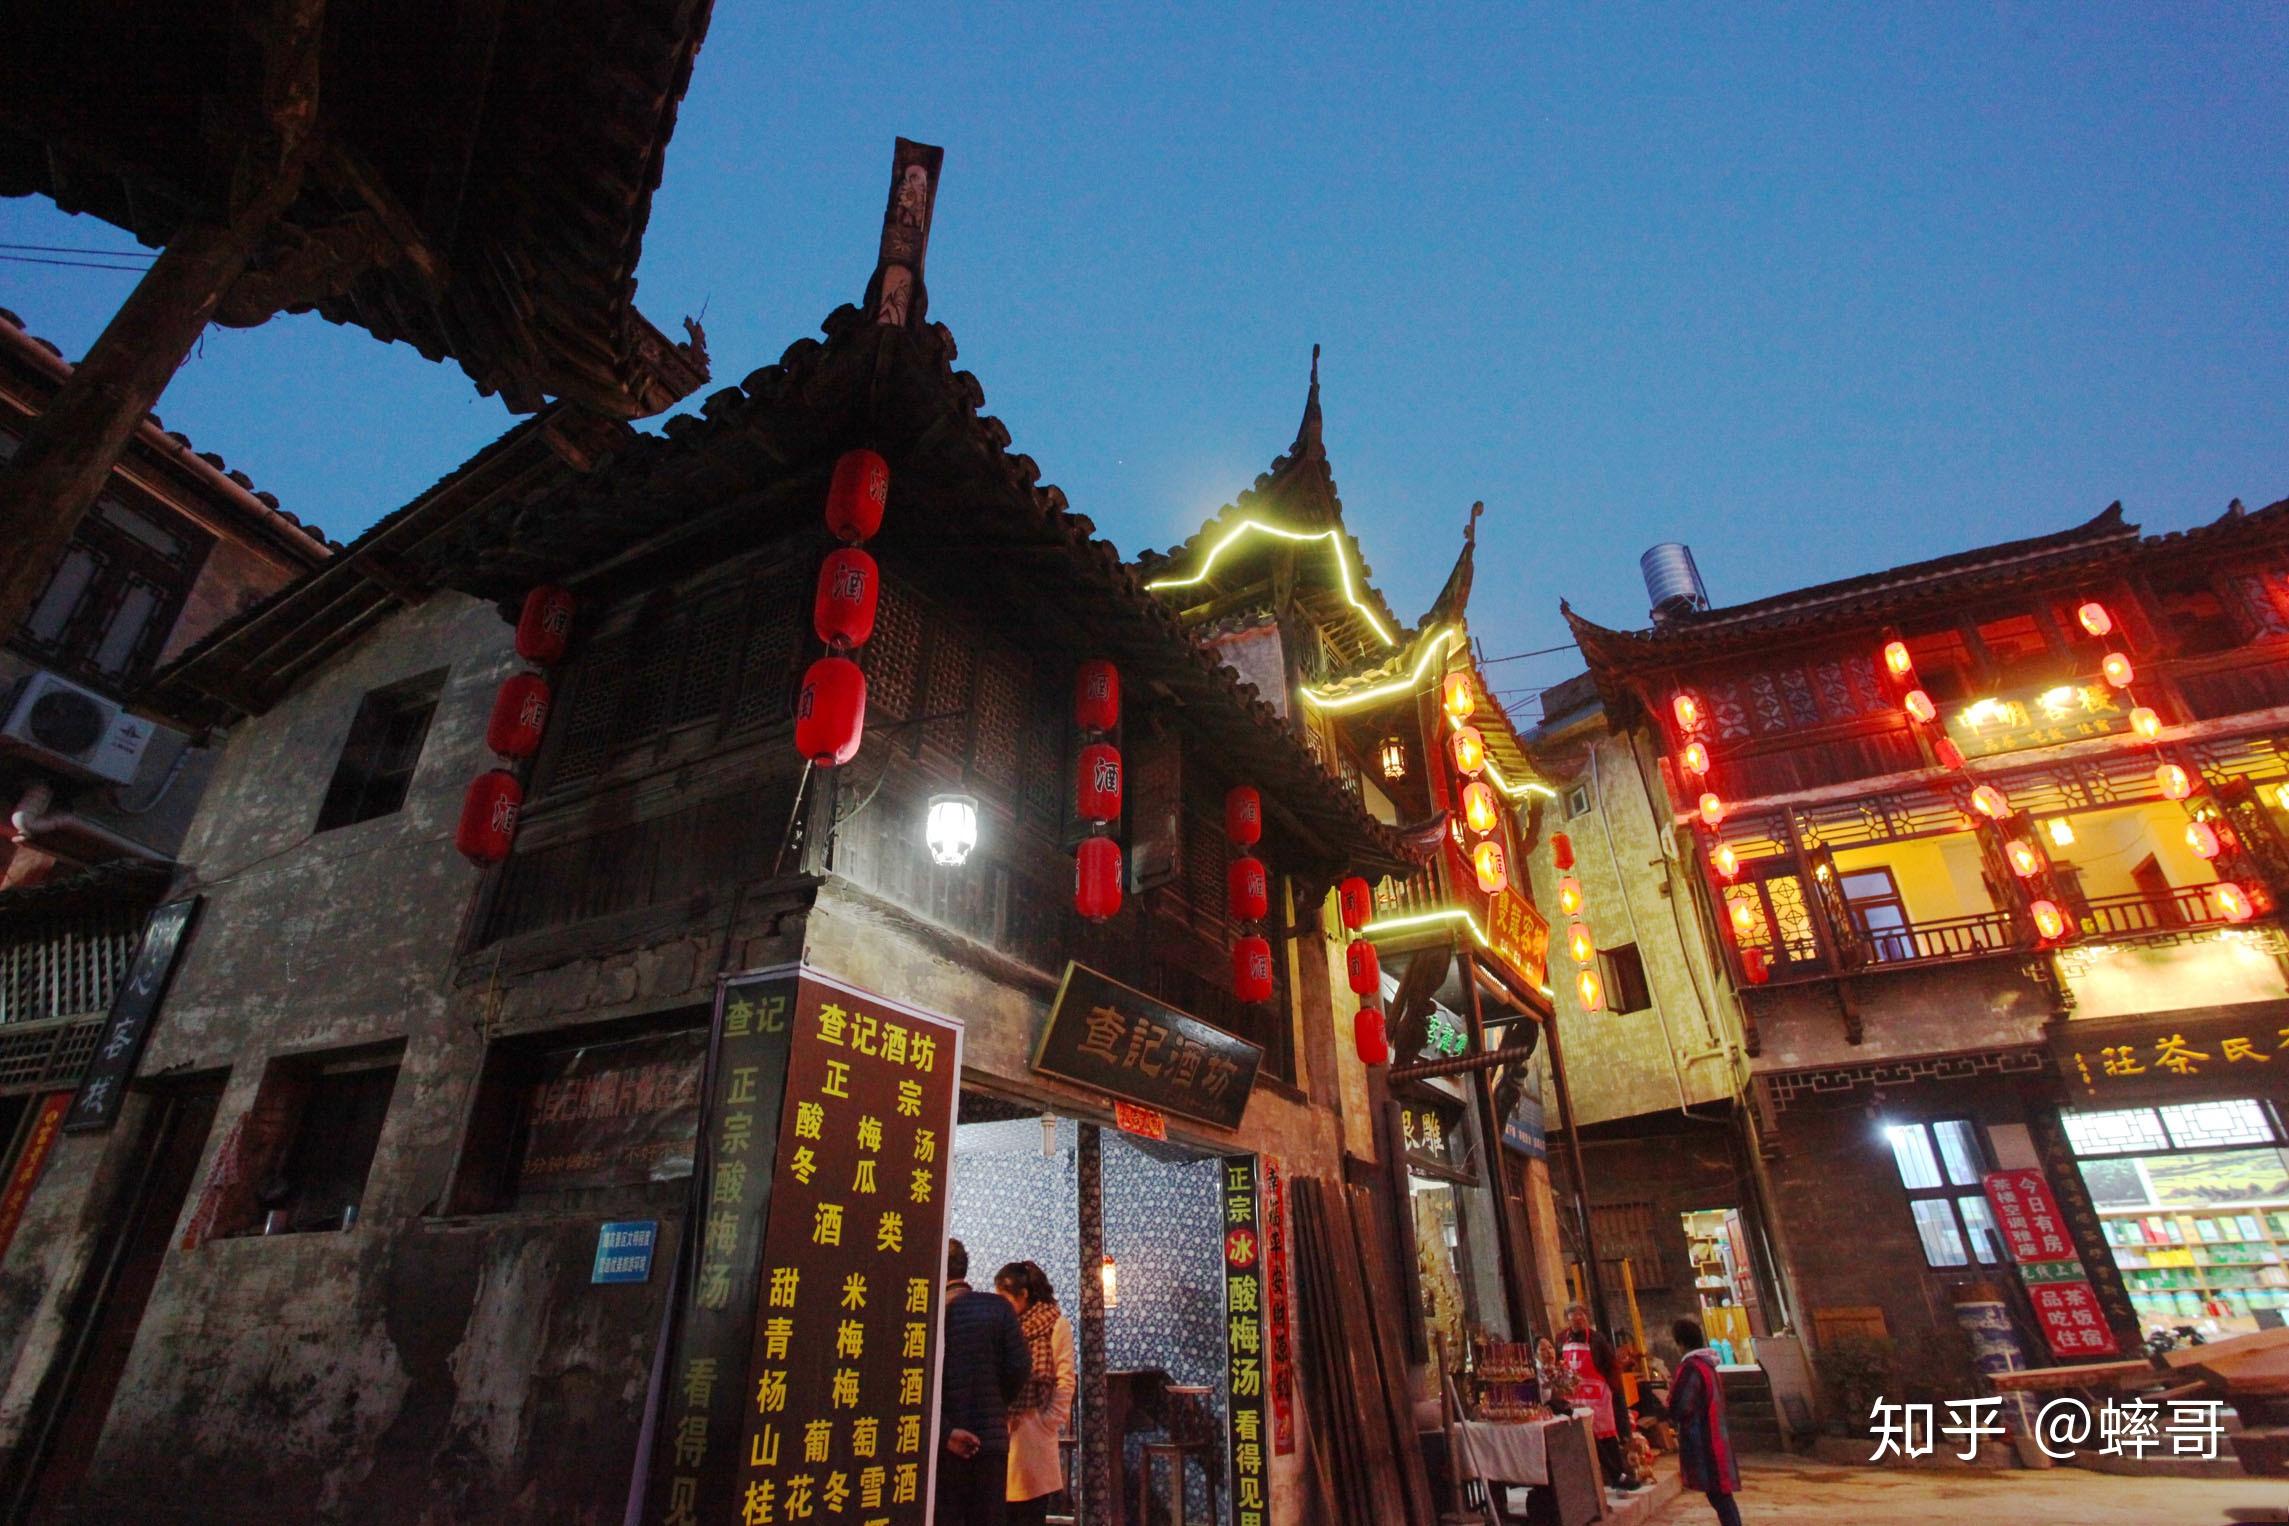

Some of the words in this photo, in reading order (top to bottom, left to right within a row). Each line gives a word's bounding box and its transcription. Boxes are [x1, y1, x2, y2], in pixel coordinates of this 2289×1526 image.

[833, 563, 867, 606] 酒
[542, 597, 571, 640] 酒
[520, 690, 548, 733] 酒
[1094, 758, 1118, 797] 酒
[491, 793, 518, 834] 酒
[1239, 799, 1257, 823] 酒
[1248, 870, 1264, 898] 酒
[1250, 949, 1268, 980] 酒
[724, 995, 786, 1038] 查记
[816, 1003, 937, 1073] 查记酒坊
[1077, 1004, 1239, 1100] 查記酒坊
[821, 1059, 923, 1118] 正宗
[795, 1101, 935, 1164] 酸梅汤
[697, 1067, 759, 1309] 正宗酸梅汤
[791, 1146, 934, 1203] 冬瓜茶
[813, 1202, 904, 1253] 酒类
[2018, 1176, 2065, 1254] 今日有房
[769, 1267, 930, 1313] 甜米酒
[1227, 1167, 1261, 1397] 正宗冰酸梅汤
[2041, 1288, 2087, 1307] 品茶
[763, 1317, 927, 1360] 青梅酒
[2047, 1309, 2097, 1328] 吃饭
[2056, 1328, 2105, 1348] 住宿
[756, 1368, 925, 1414] 杨梅酒
[663, 1357, 718, 1526] 看得见
[750, 1414, 921, 1467] 山葡萄酒
[741, 1463, 919, 1526] 桂花冬雪酒
